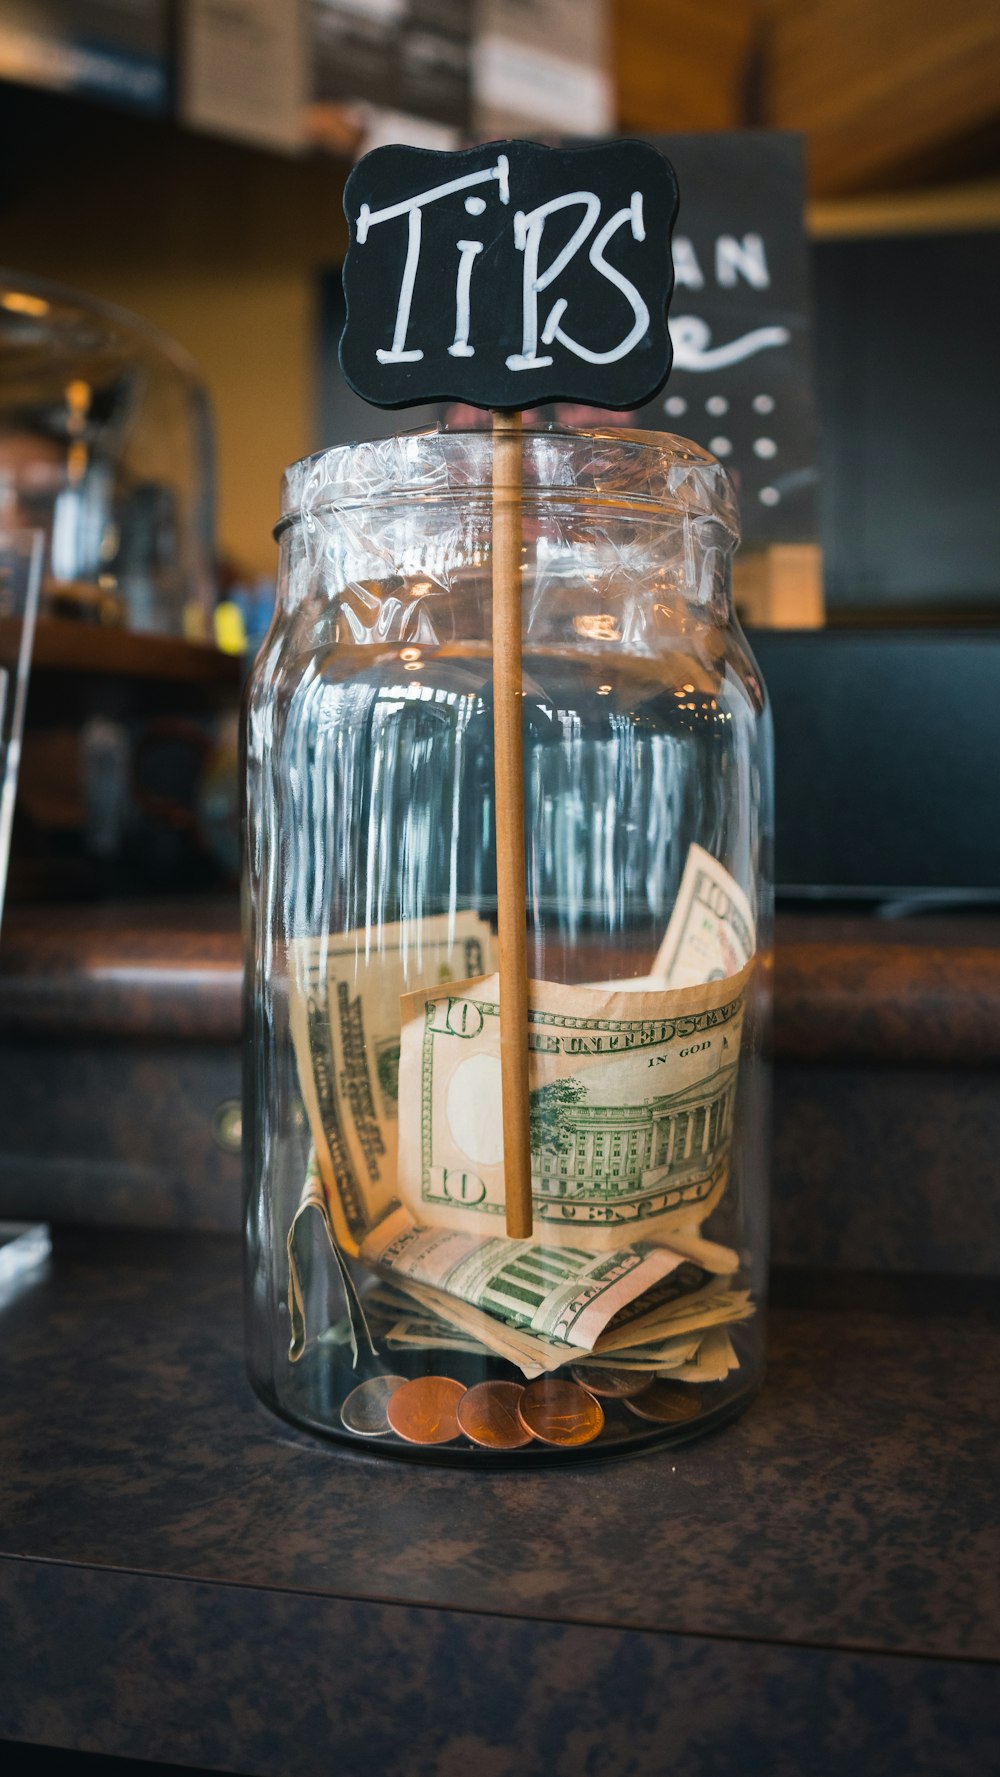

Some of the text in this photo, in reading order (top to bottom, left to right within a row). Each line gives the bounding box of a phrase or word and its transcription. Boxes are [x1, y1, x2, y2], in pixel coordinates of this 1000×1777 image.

[426, 997, 484, 1039] 10
[561, 1021, 677, 1057] UNITED
[647, 1040, 712, 1068] IN GOD
[425, 1166, 487, 1207] 10
